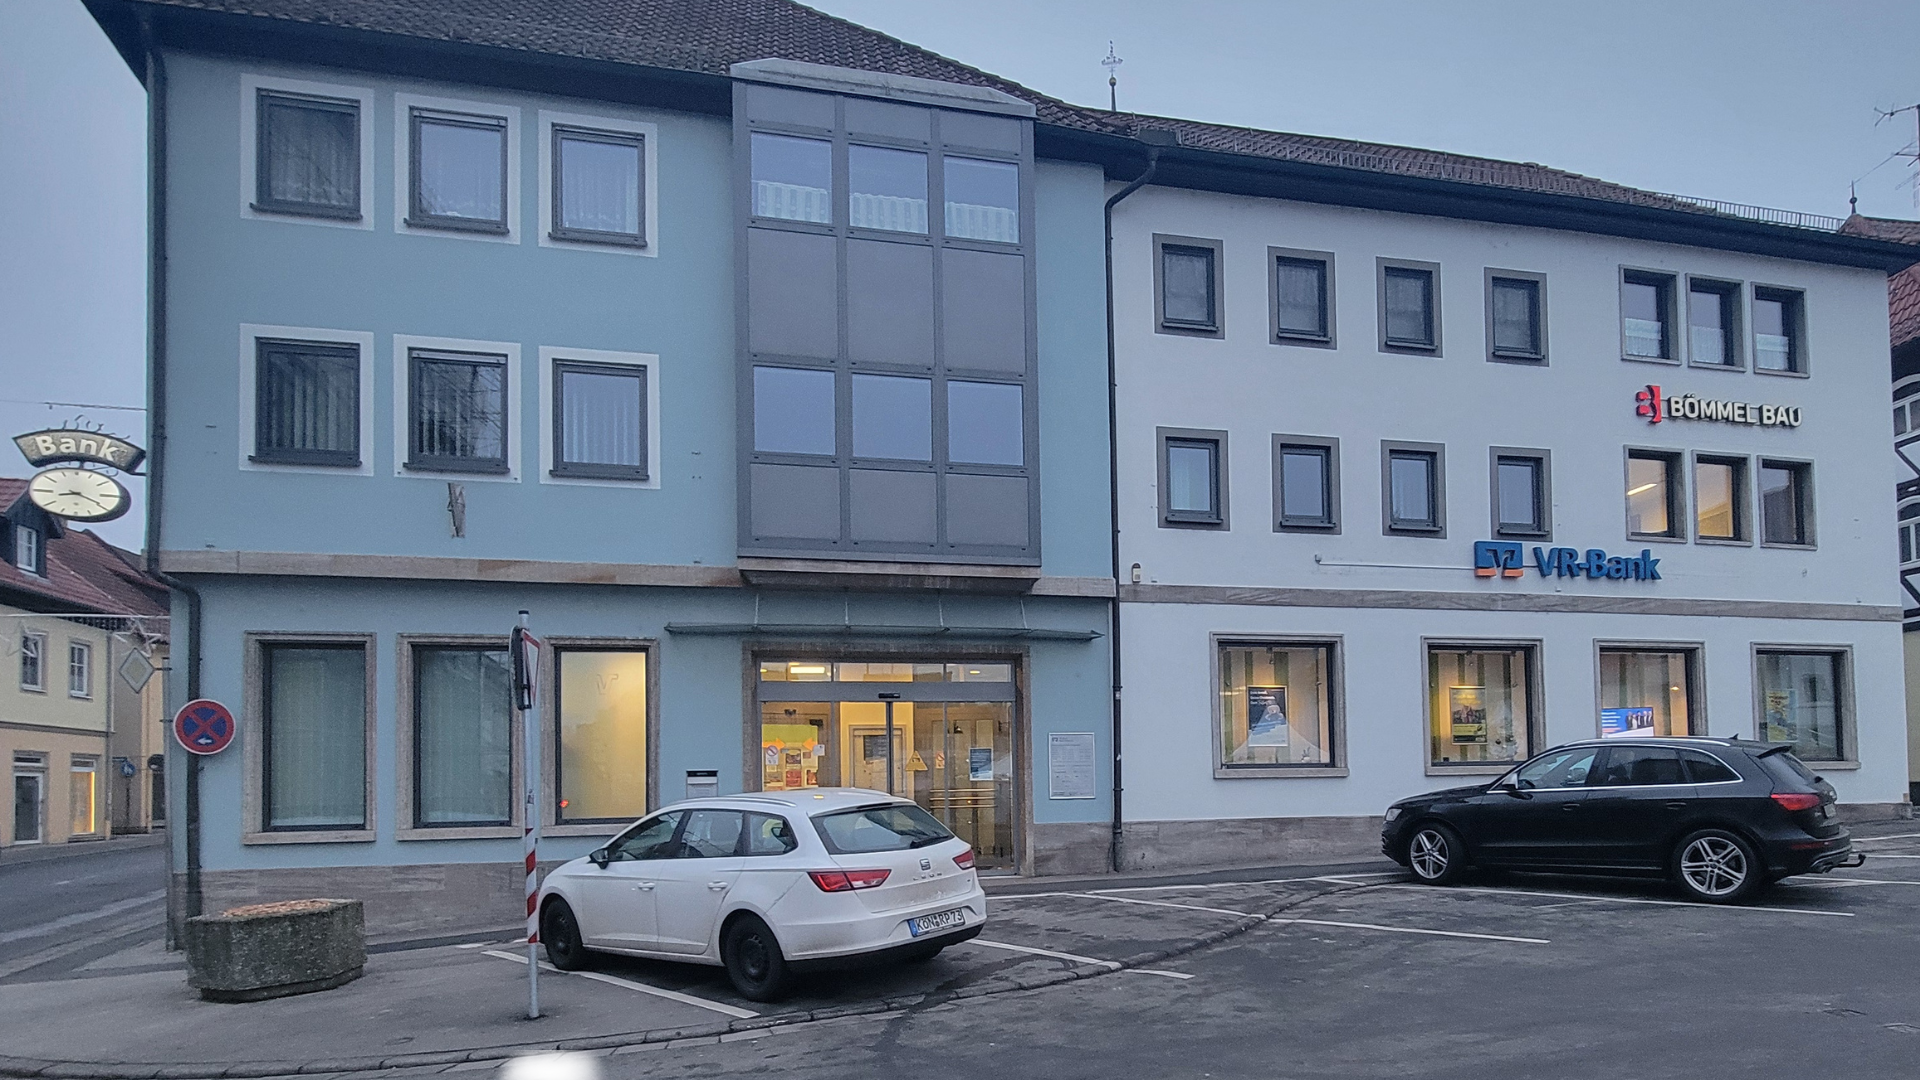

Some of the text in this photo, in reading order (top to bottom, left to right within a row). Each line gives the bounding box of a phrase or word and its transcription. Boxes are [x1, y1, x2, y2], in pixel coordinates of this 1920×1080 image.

[1669, 393, 1803, 427] BÖMMEL BAU
[35, 435, 119, 462] Bank
[1532, 546, 1662, 580] VR-Bank
[938, 912, 950, 926] RP
[950, 909, 963, 922] 73
